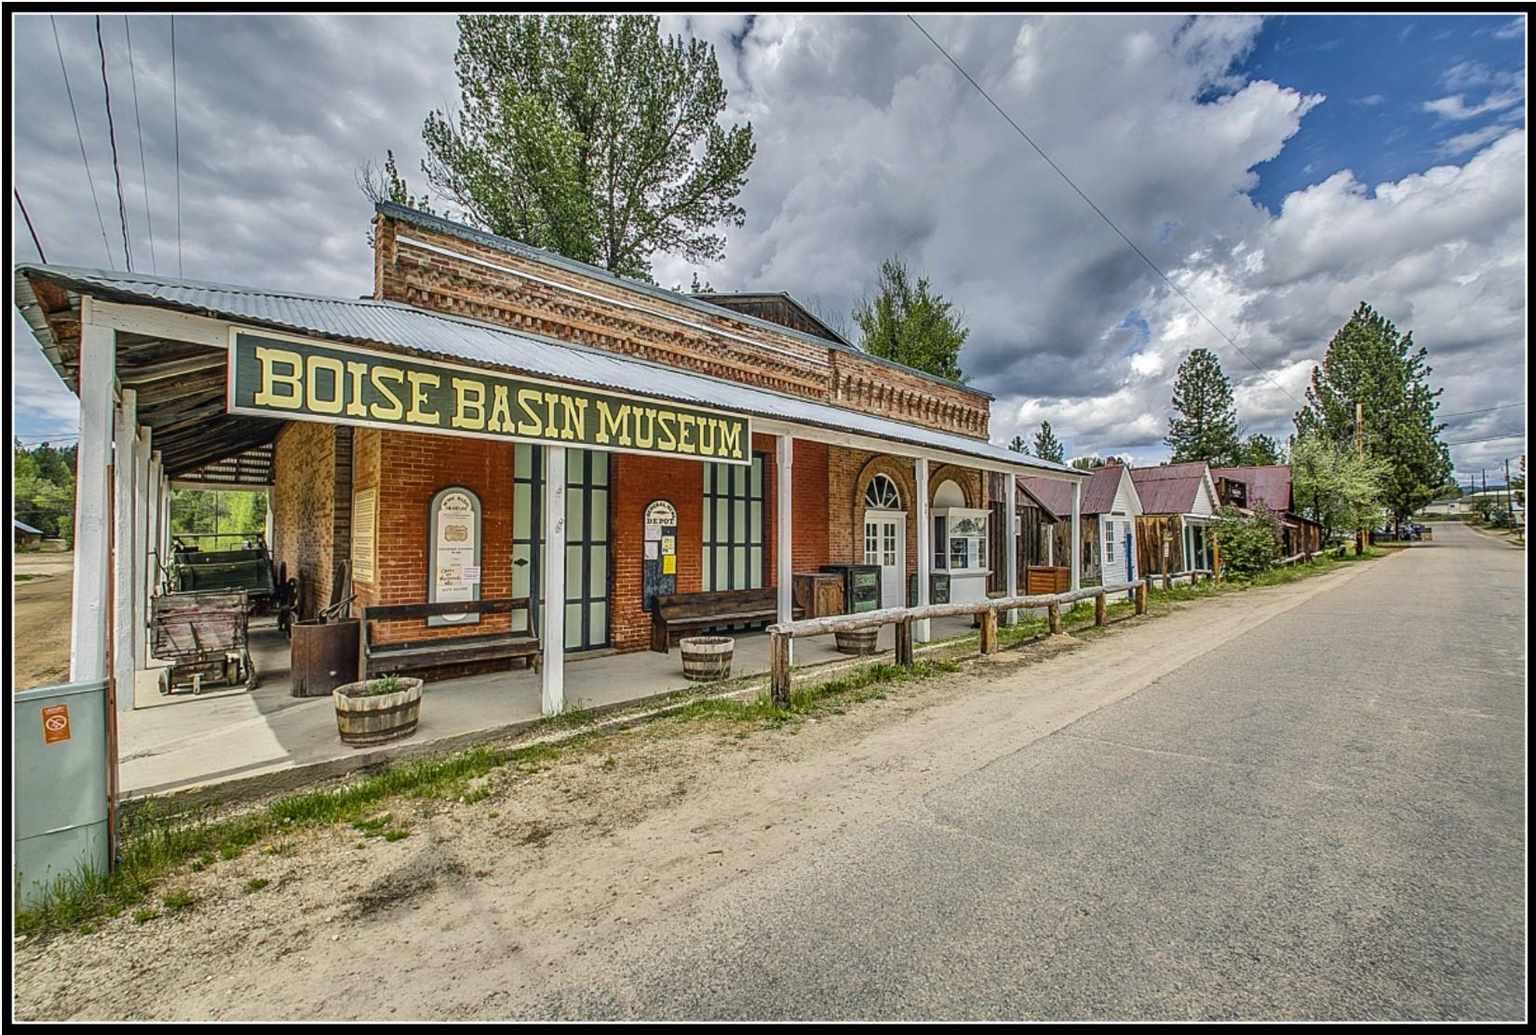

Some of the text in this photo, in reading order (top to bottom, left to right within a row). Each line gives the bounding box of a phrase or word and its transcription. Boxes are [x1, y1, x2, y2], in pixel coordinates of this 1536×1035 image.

[255, 346, 743, 460] BOISE BASIN MUSEUM
